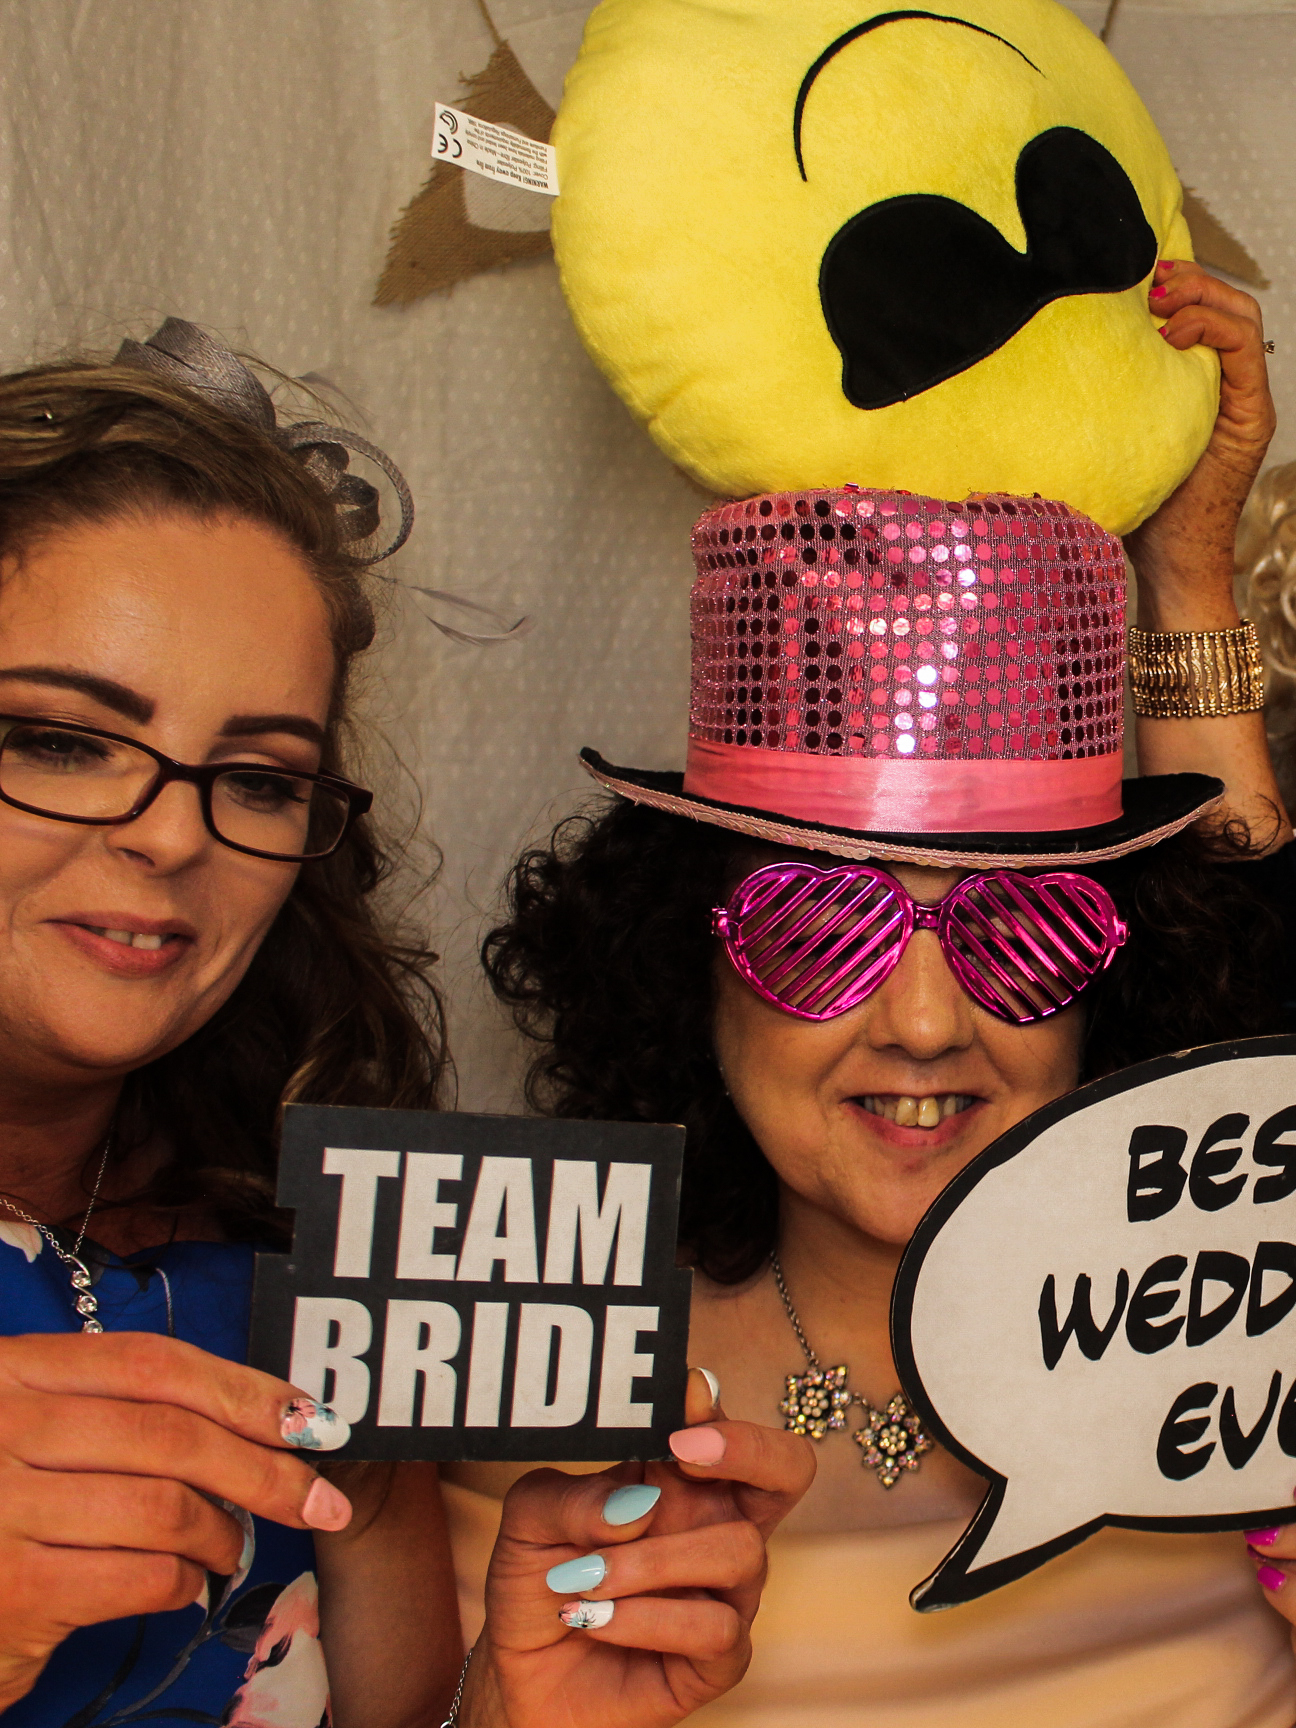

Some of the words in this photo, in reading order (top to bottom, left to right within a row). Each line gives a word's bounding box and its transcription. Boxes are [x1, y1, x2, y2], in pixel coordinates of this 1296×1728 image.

[437, 133, 463, 158] CE
[322, 1146, 653, 1286] TEAM
[289, 1296, 660, 1428] BRIDE
